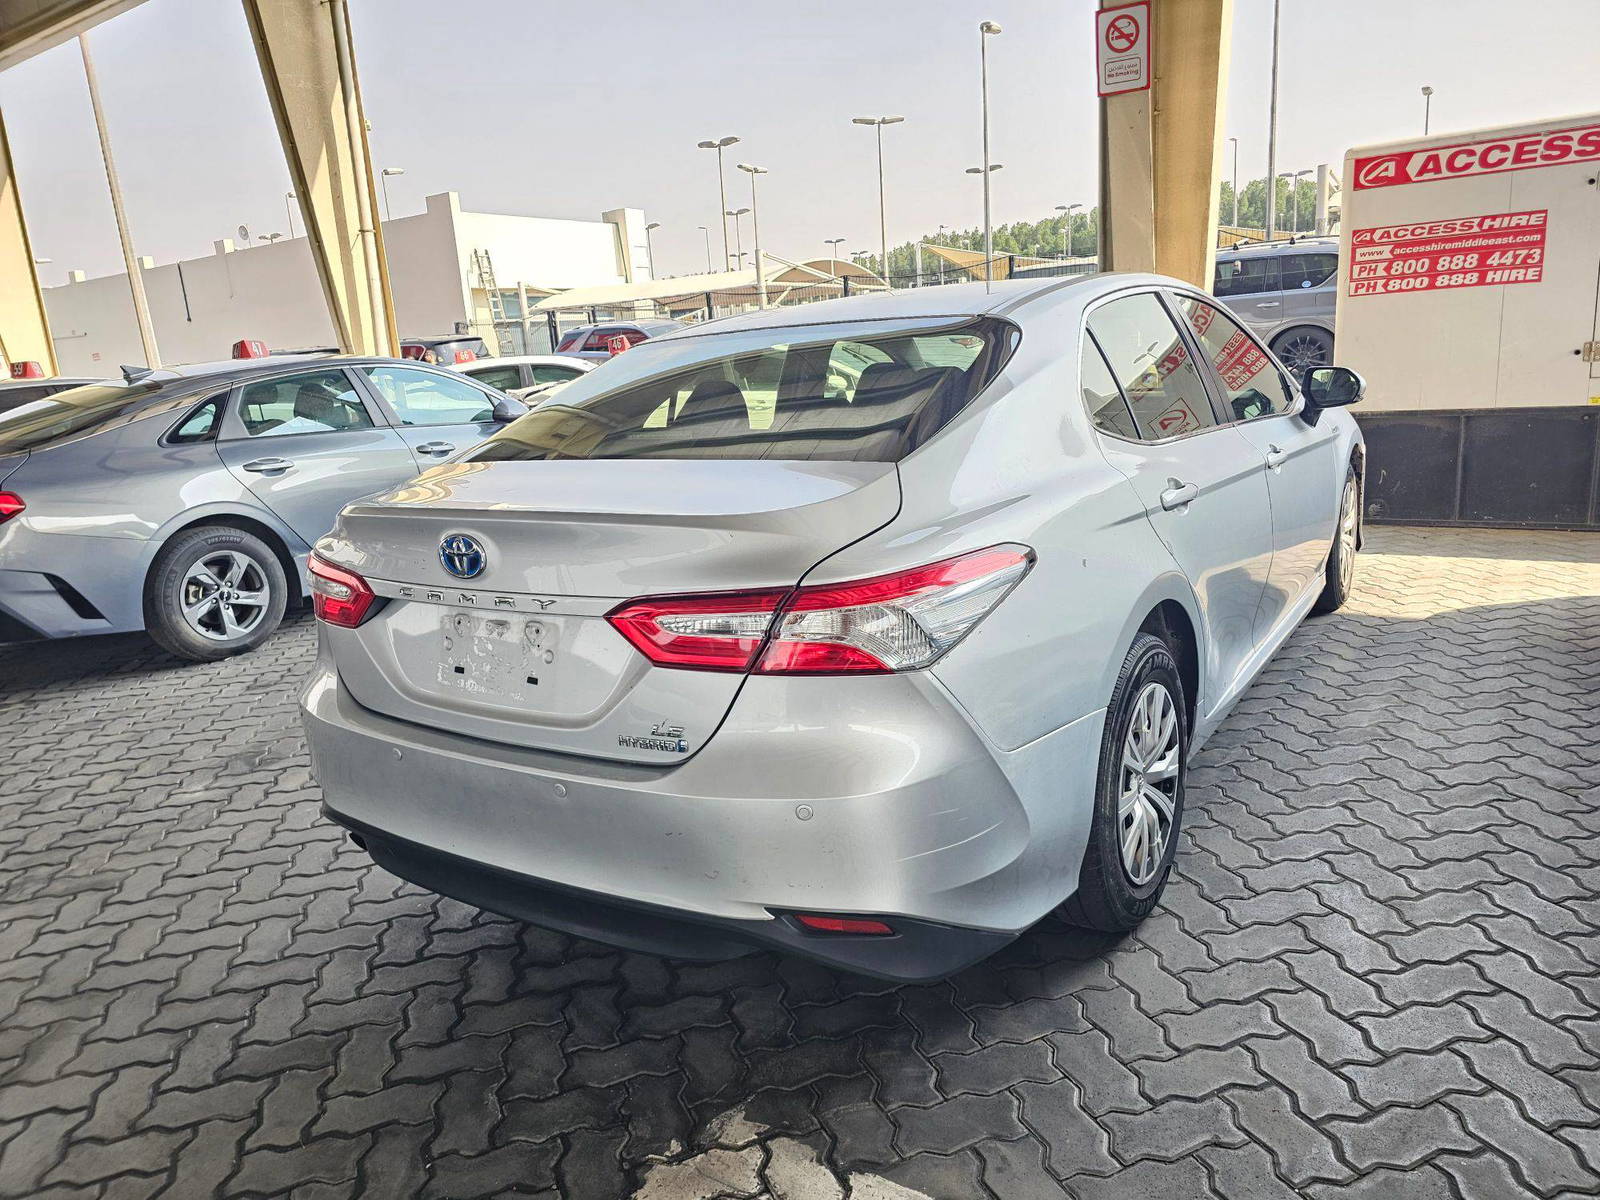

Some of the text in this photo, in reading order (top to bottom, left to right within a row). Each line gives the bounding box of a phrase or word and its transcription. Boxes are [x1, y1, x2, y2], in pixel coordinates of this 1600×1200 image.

[1414, 131, 1600, 178] ACCESS
[1378, 219, 1477, 241] ACCESS
[1482, 213, 1546, 230] HIRE
[1394, 234, 1541, 255] accesshiremiddleeast.com
[1358, 248, 1541, 277] PH 800 888 4473
[1354, 267, 1541, 294] PH 800 888 HIRE
[399, 586, 557, 611] CAMRY
[651, 719, 685, 738] LE
[617, 735, 677, 752] HYBRID
